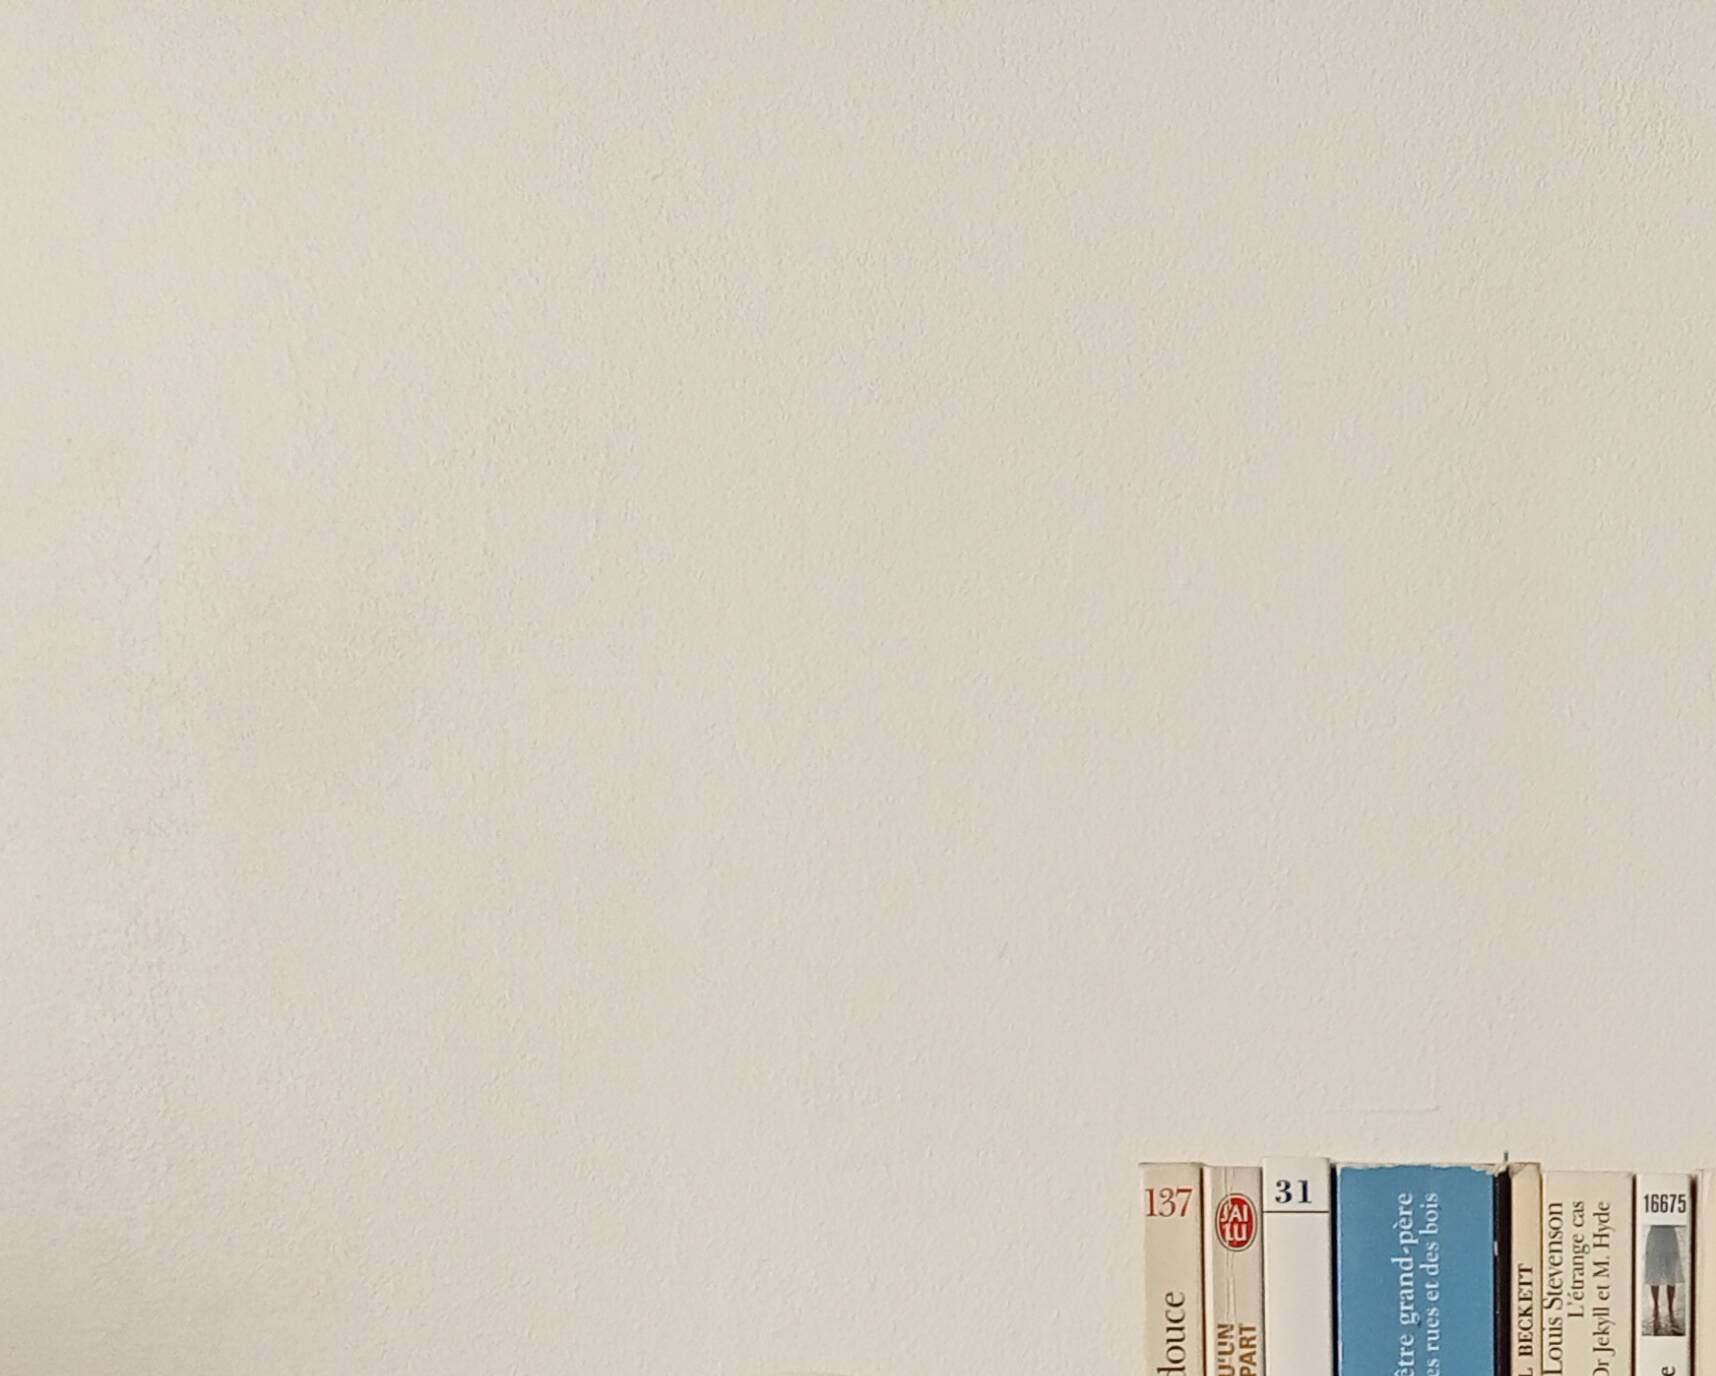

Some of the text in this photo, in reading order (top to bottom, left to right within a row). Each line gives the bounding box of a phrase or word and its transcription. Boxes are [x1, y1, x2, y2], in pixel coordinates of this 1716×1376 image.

[1145, 1188, 1193, 1218] 137
[1274, 1180, 1311, 1205] 31
[1644, 1194, 1686, 1214] 16675
[1419, 1193, 1440, 1235] bois
[1570, 1200, 1586, 1228] cas
[1592, 1202, 1615, 1249] Hyde
[1393, 1193, 1422, 1326] grand-père
[1420, 1242, 1440, 1275] des
[1542, 1202, 1564, 1311] Stevenson
[1593, 1255, 1611, 1279] M.
[1423, 1281, 1440, 1301] et
[1595, 1284, 1611, 1301] et
[1517, 1263, 1534, 1357] BECKETT
[1425, 1308, 1440, 1352] rues
[1542, 1317, 1564, 1376] Louis
[1592, 1307, 1616, 1356] Jekyll
